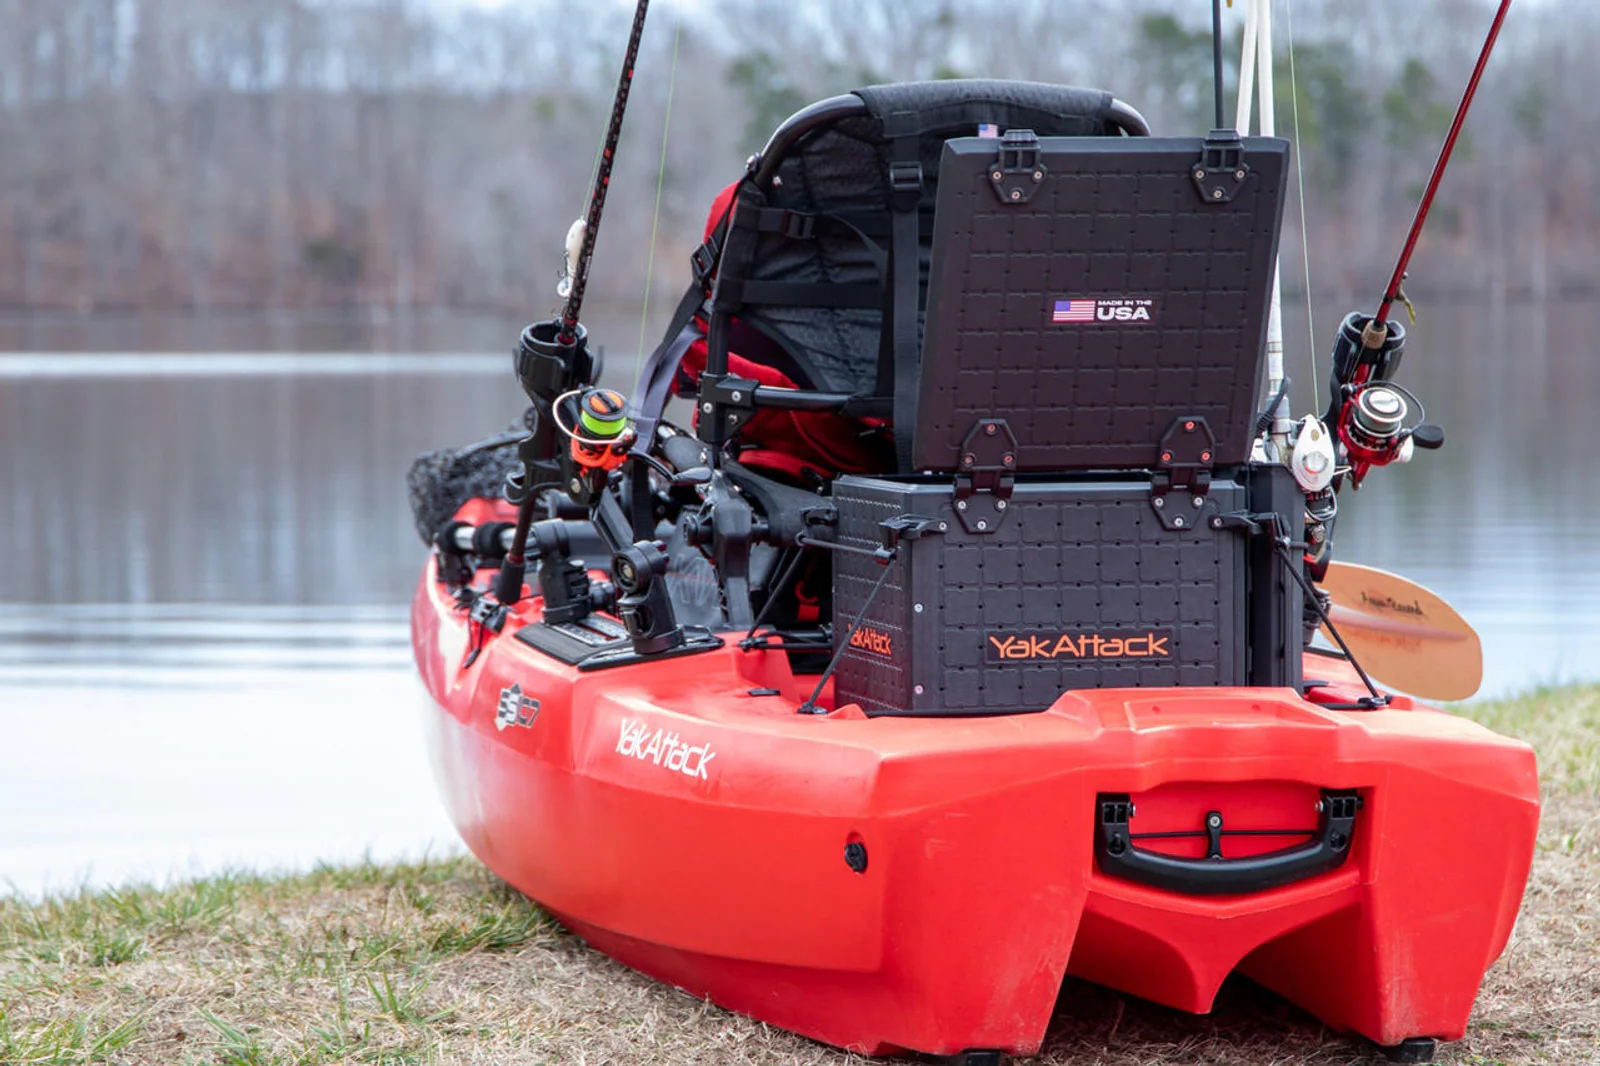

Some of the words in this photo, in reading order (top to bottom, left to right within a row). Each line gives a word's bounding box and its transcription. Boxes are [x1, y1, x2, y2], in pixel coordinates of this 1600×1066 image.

[1097, 307, 1150, 321] USA
[989, 632, 1169, 659] YakAttack
[615, 718, 717, 780] YakAttack
